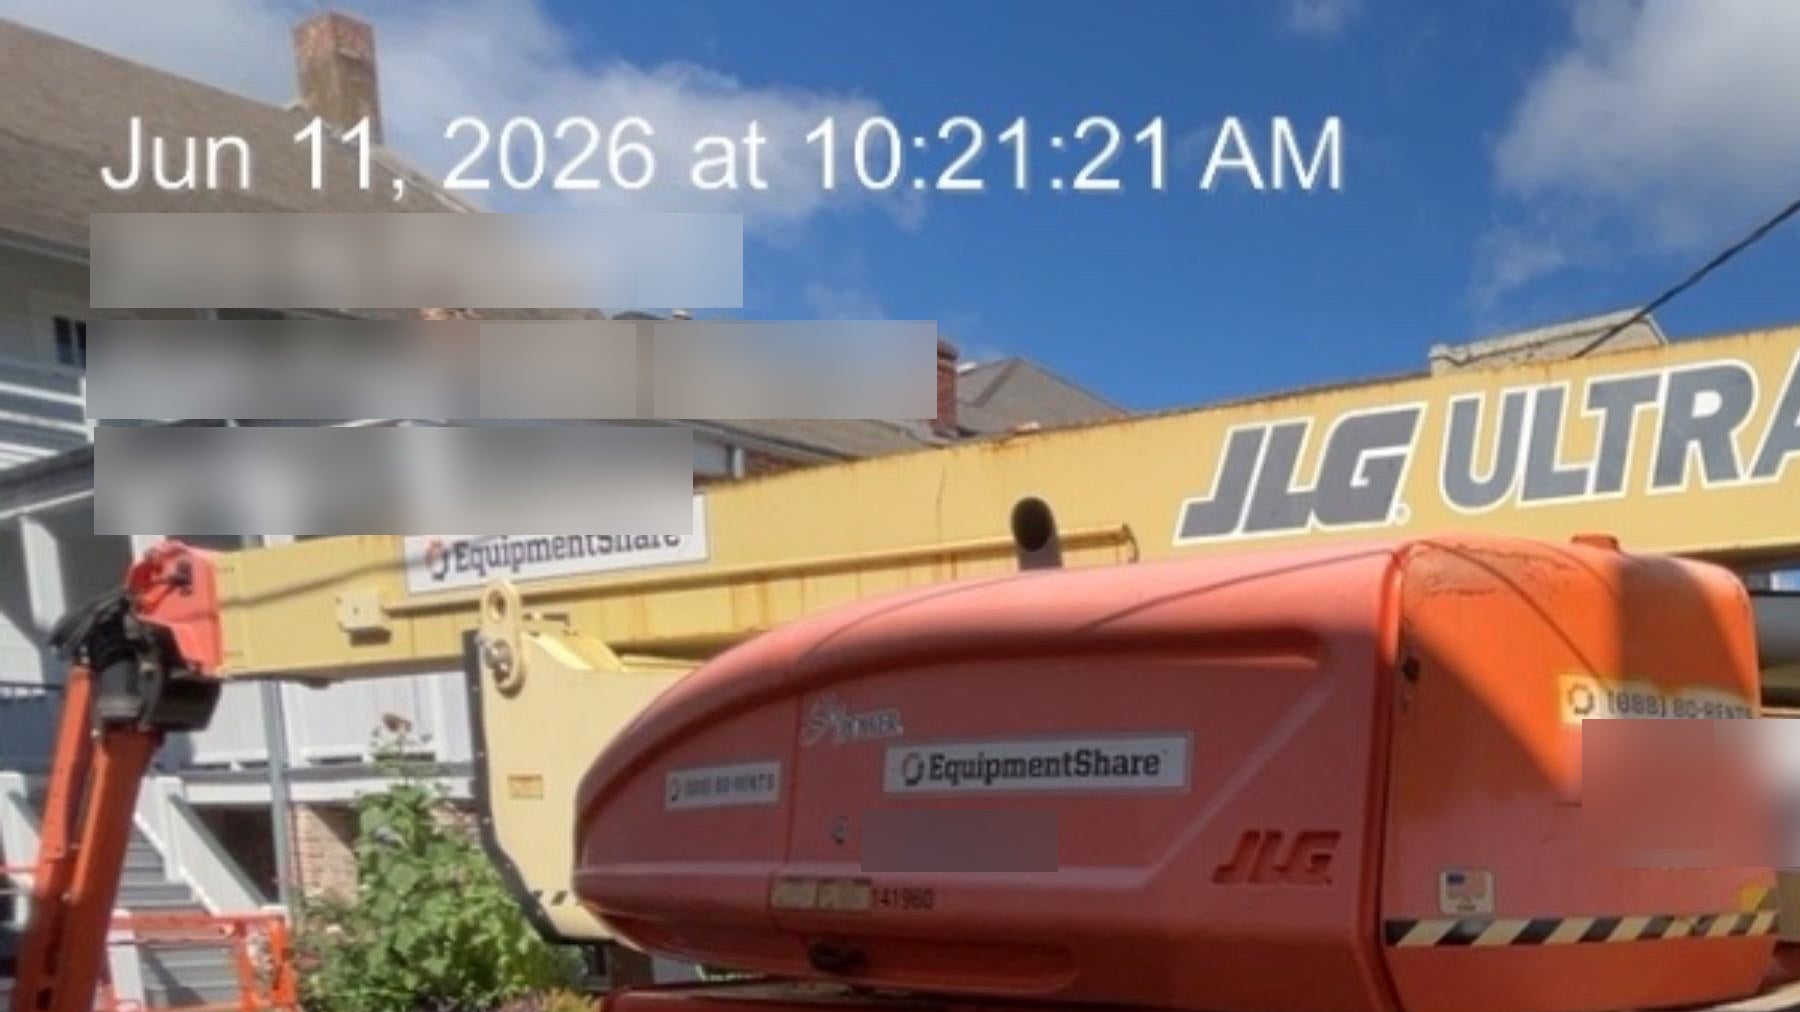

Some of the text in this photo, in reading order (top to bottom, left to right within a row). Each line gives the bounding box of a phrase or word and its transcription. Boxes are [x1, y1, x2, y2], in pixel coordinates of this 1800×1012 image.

[1173, 401, 1429, 546] JLG
[929, 748, 1162, 786] EquipmentShare
[1211, 828, 1342, 886] JLG
